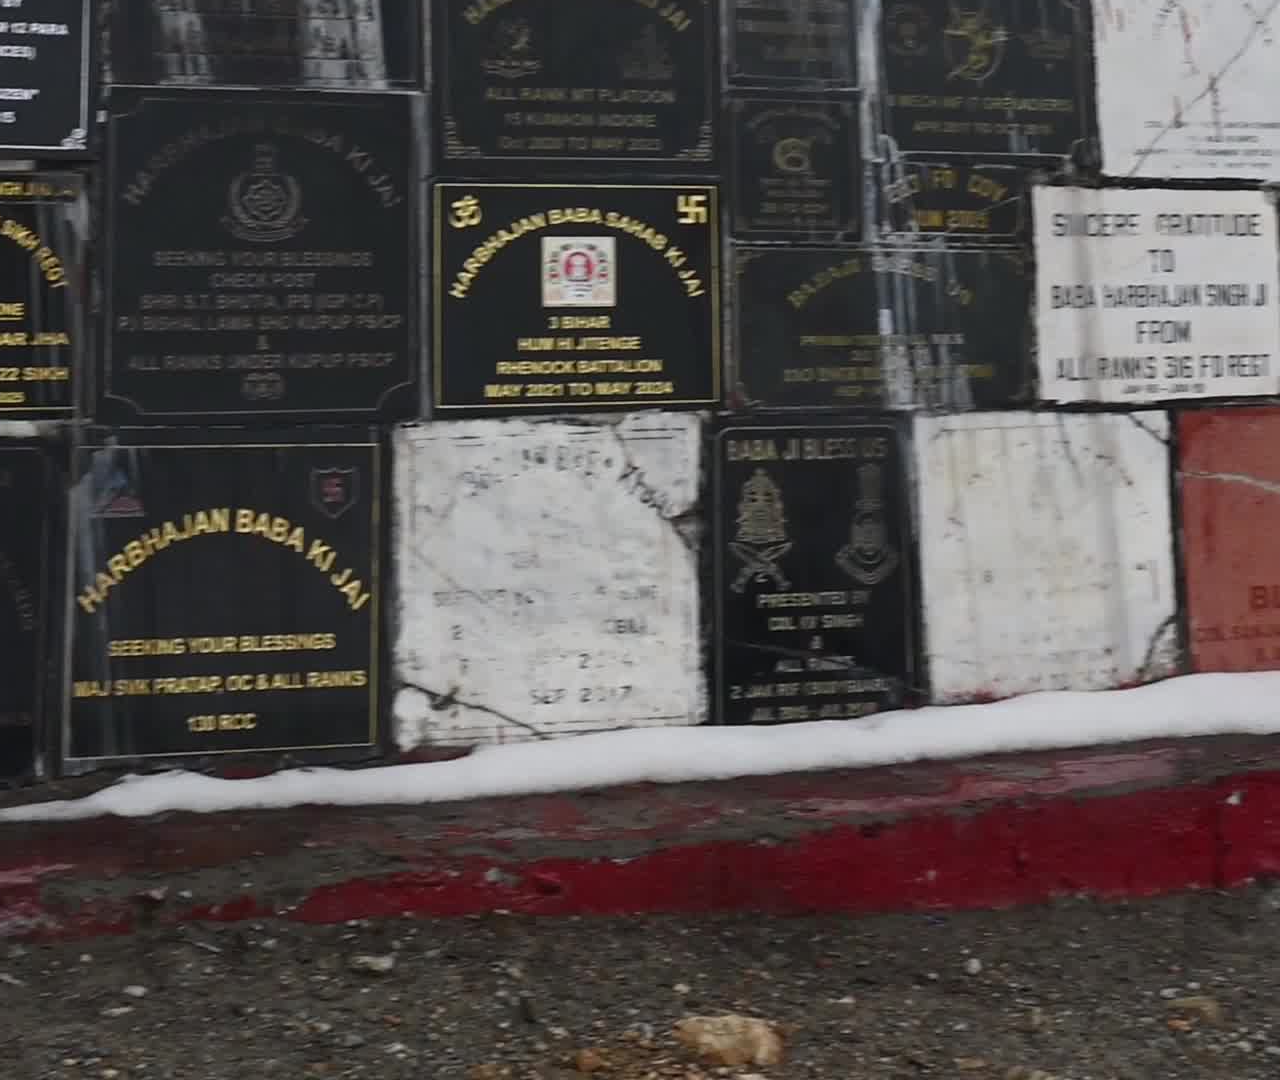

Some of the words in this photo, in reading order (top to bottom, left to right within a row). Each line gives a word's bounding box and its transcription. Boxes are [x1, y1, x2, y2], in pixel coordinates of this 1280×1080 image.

[1050, 212, 1142, 238] SINCERE
[1154, 212, 1263, 238] GRATITUDE
[0, 218, 41, 251] SIKH
[34, 246, 70, 289] REGT
[447, 212, 548, 299] HARBHAJAN
[546, 207, 603, 226] BABA
[664, 245, 688, 268] KI
[677, 269, 706, 298] JAI
[1146, 248, 1177, 274] TO
[1050, 284, 1098, 310] BABA
[1204, 282, 1249, 308] SINGH
[1135, 319, 1193, 346] FROM
[21, 367, 70, 381] SIKH
[576, 359, 664, 374] BATTALION
[1055, 356, 1097, 382] ALL
[1096, 355, 1159, 380] RANKS
[483, 383, 524, 398] MAY
[567, 383, 593, 396] TO
[594, 382, 634, 396] MAY
[726, 438, 780, 462] BABA
[799, 436, 858, 461] BLESS
[76, 507, 231, 614] HARBHAJAN
[233, 507, 306, 554] BABA
[304, 538, 338, 573] KI
[329, 567, 371, 612] JAI
[107, 637, 186, 657] SEEKING
[187, 635, 239, 654] YOUR
[238, 632, 337, 653] BLESSINGS
[224, 673, 255, 692] OC
[254, 672, 270, 691] &
[269, 671, 306, 690] ALL
[305, 669, 369, 690] RANKS
